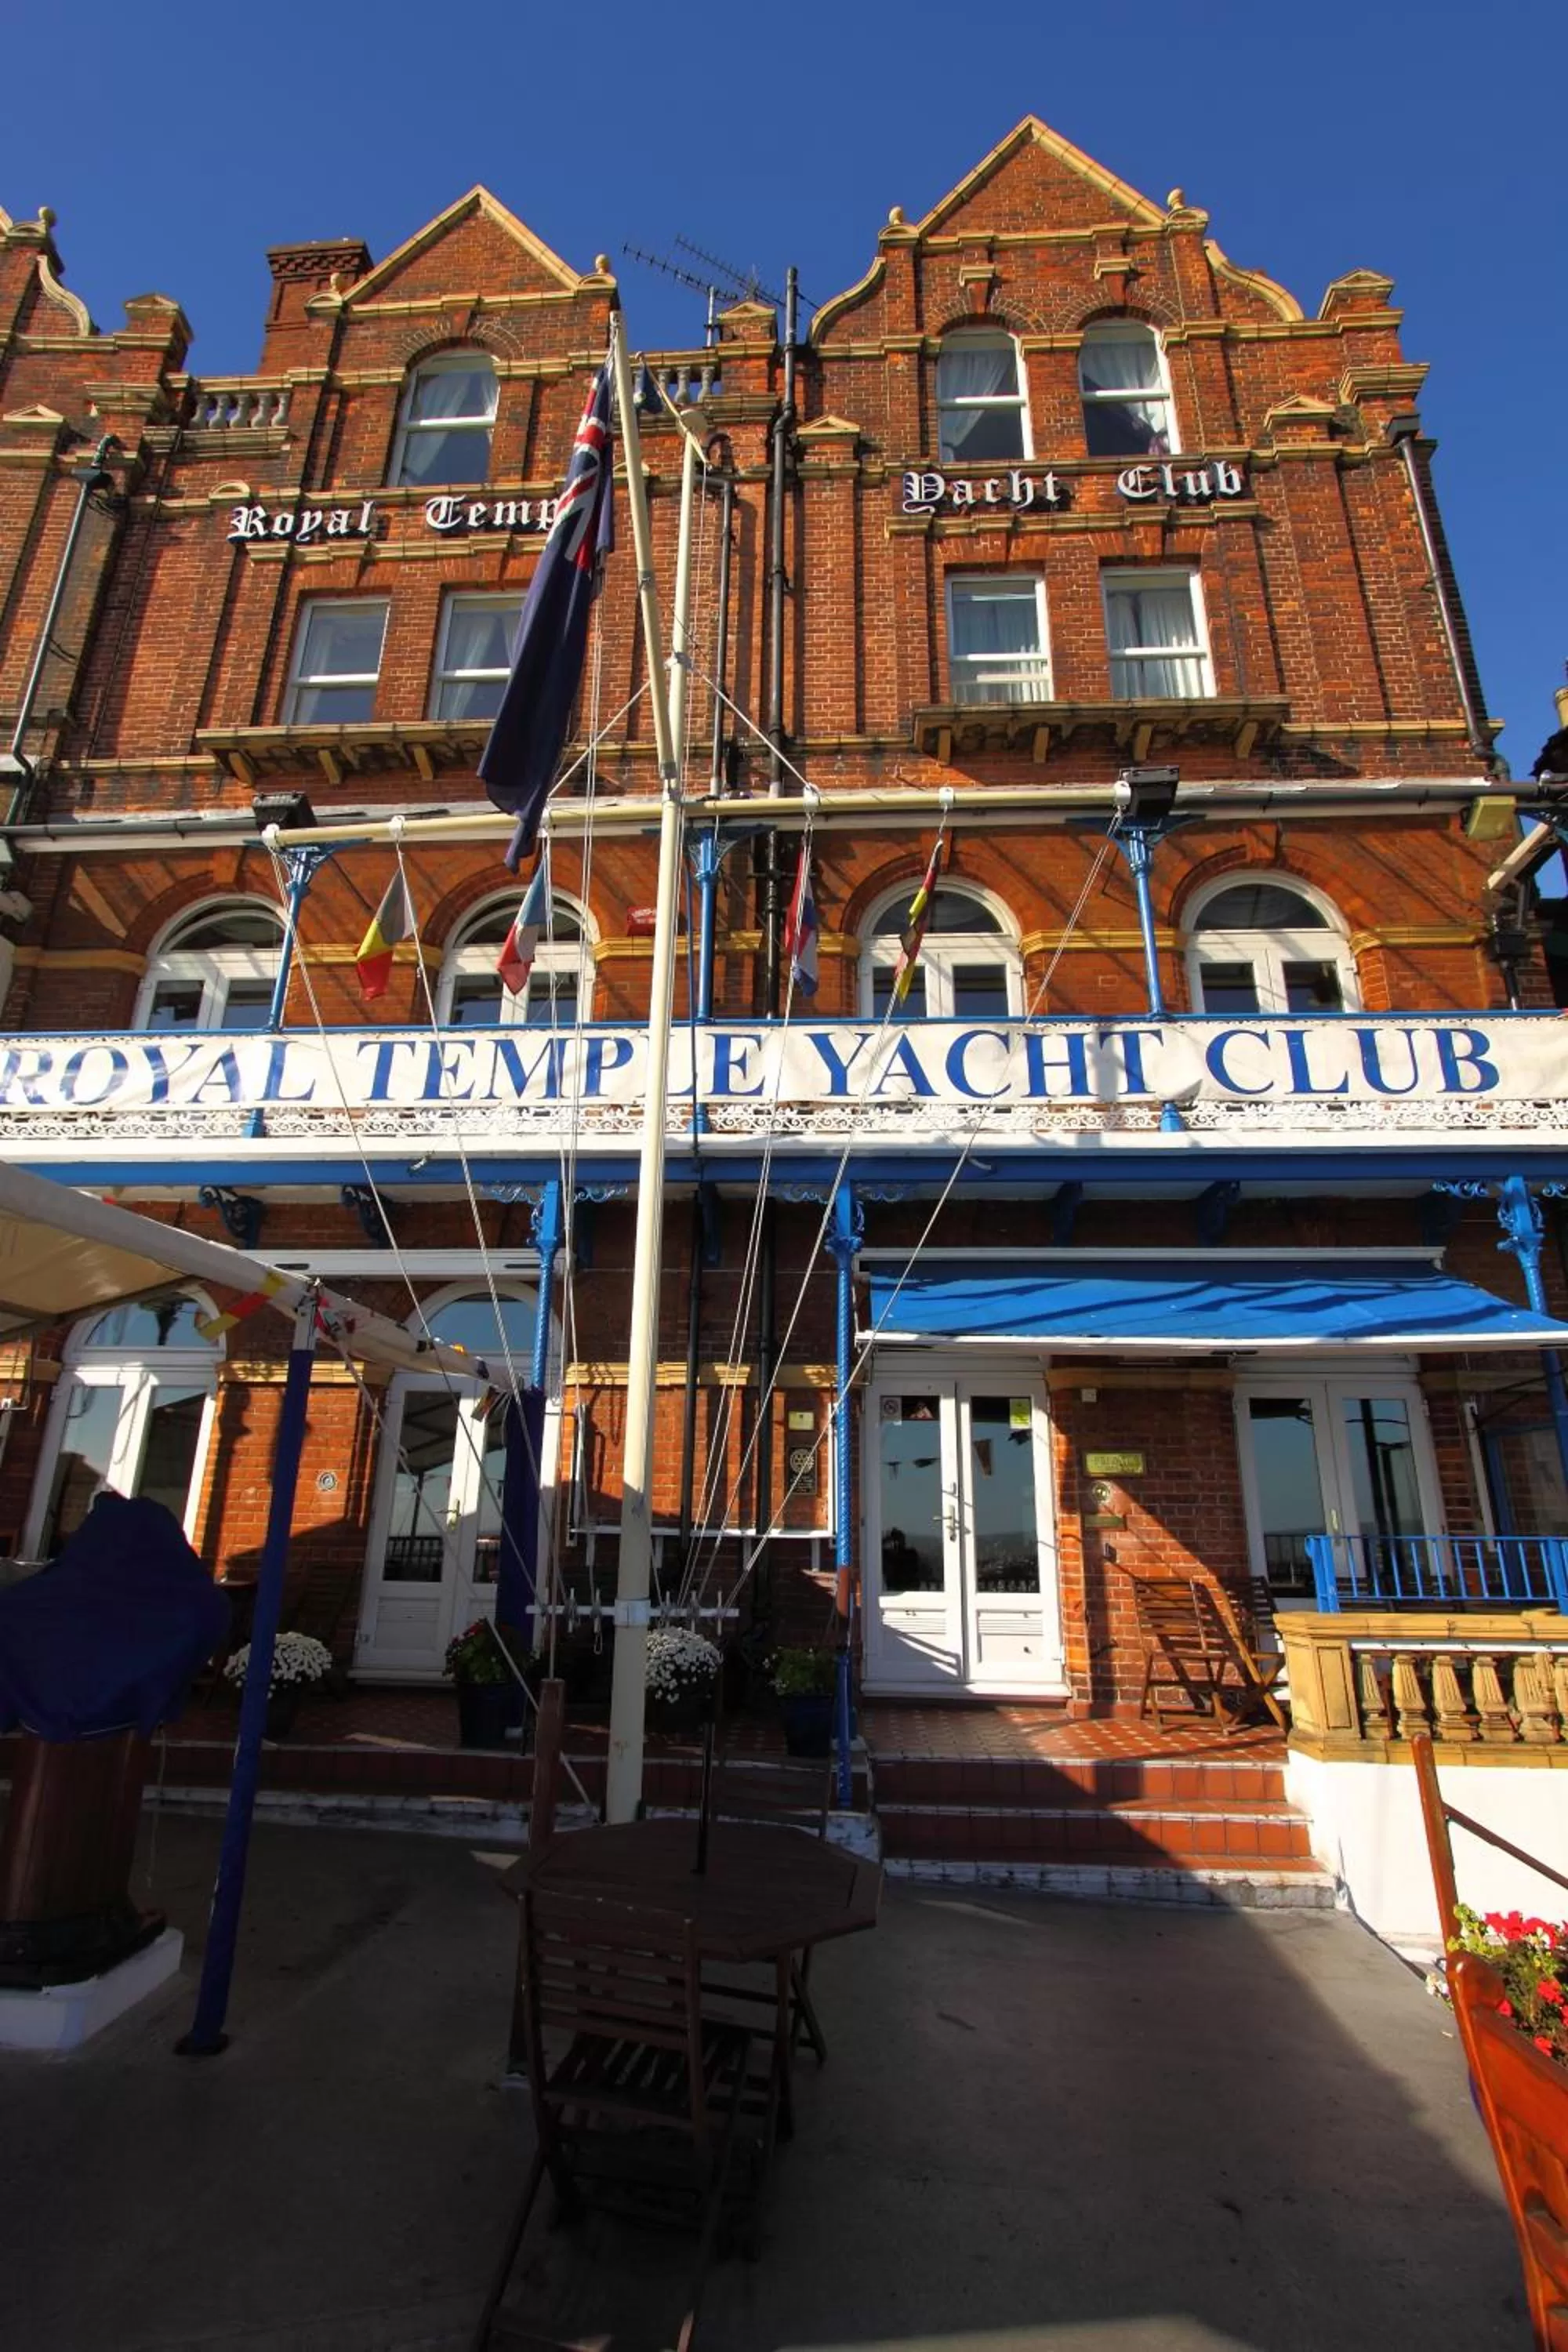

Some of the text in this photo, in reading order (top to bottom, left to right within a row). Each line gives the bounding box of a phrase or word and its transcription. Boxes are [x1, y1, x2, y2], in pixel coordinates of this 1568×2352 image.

[227, 460, 1242, 543] Royal Temp Yacht Club
[0, 1040, 317, 1105] ROYAL
[804, 1029, 1163, 1099] YACHT
[1205, 1028, 1500, 1096] CLUB
